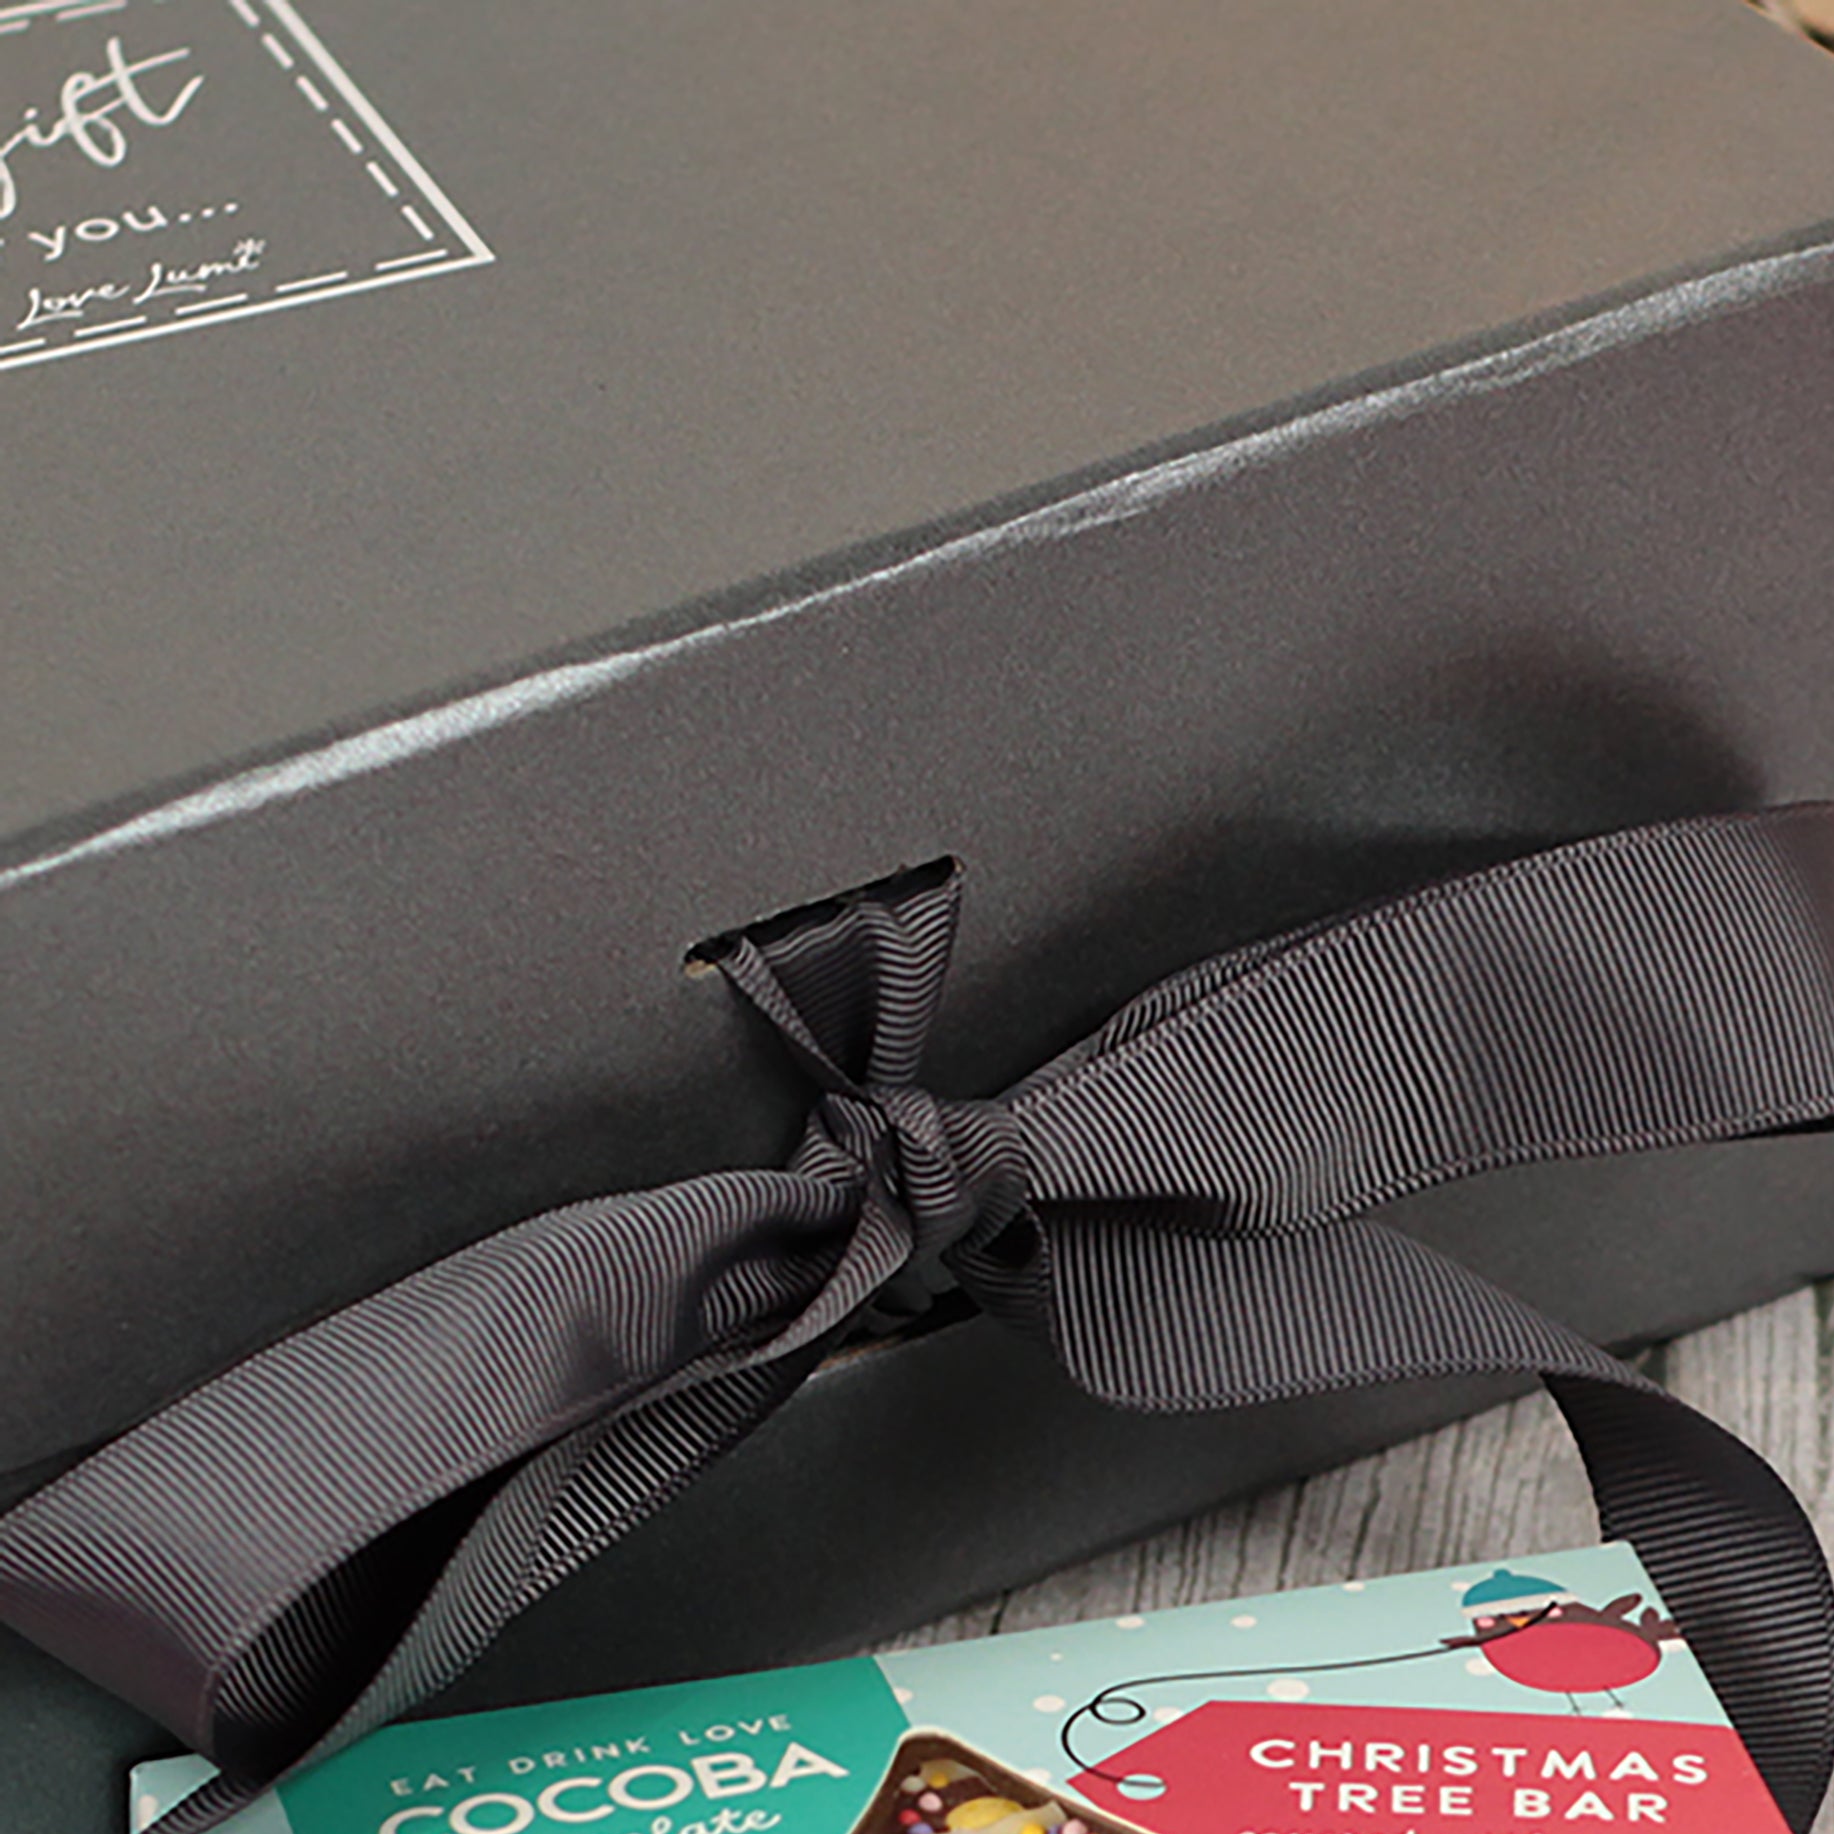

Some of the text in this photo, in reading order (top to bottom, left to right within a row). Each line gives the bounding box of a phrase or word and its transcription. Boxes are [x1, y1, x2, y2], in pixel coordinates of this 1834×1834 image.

[0, 36, 204, 218] ift
[27, 202, 239, 262] you...
[16, 287, 131, 330] Love
[390, 1713, 793, 1797] EAT DRINK LOVE
[1248, 1738, 1710, 1785] CHRISTMAS
[1288, 1781, 1669, 1824] TREE BAR
